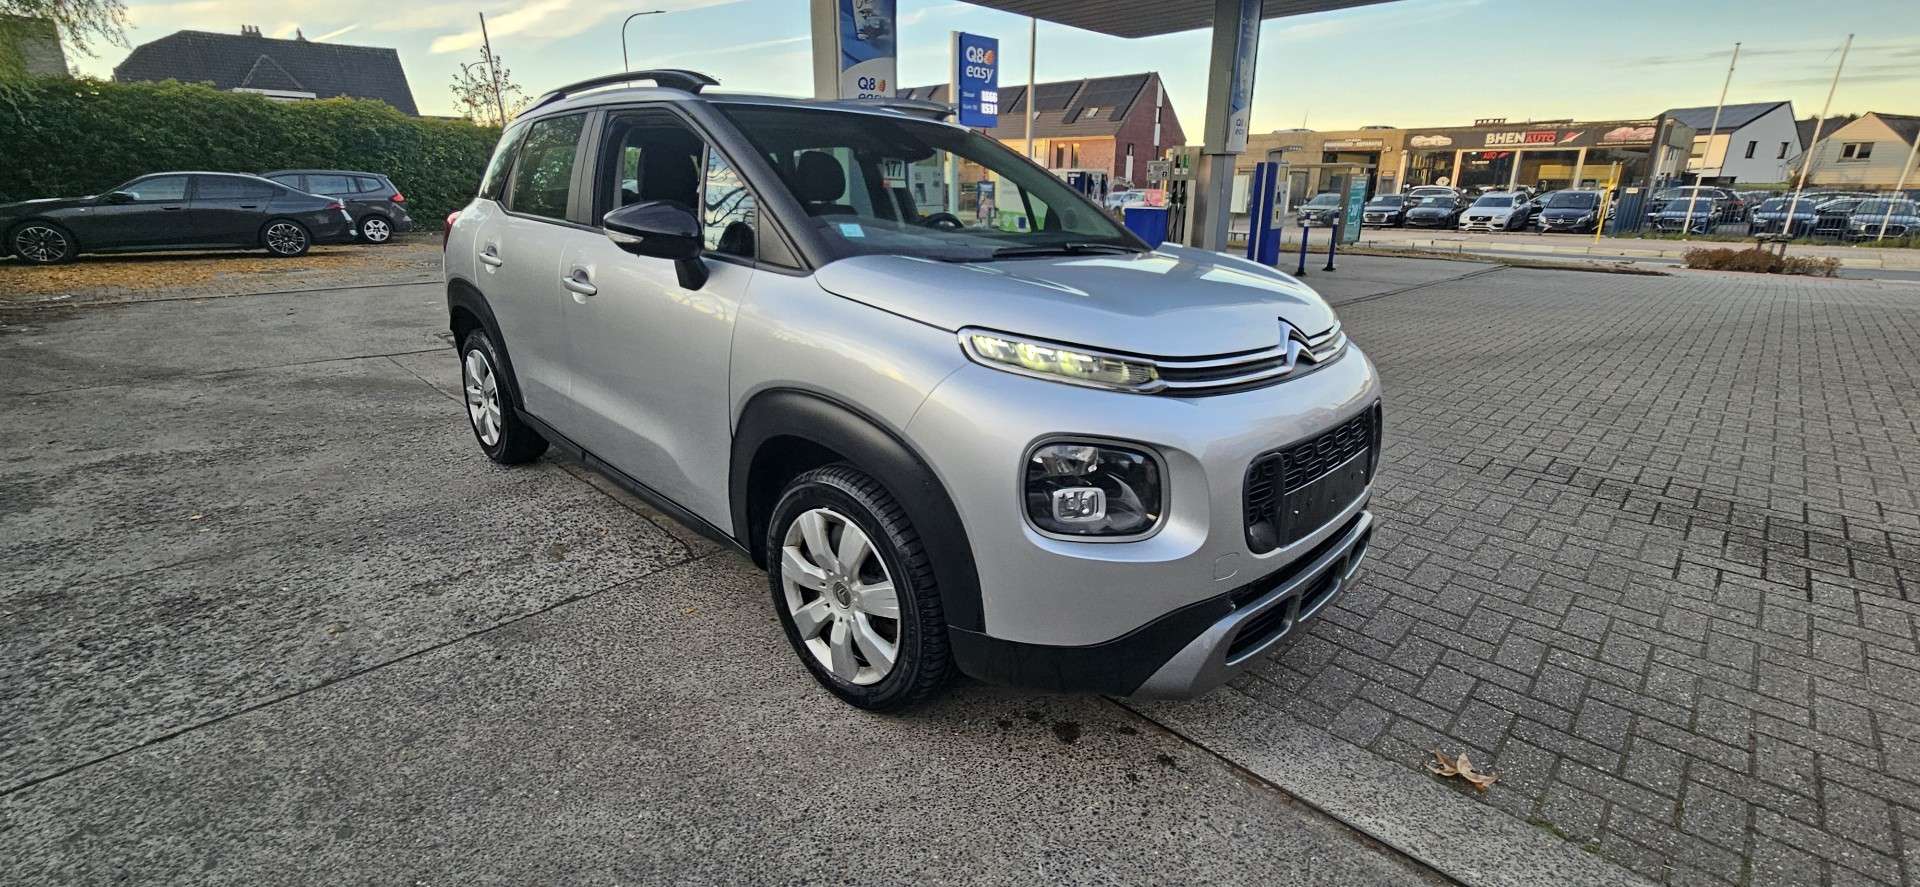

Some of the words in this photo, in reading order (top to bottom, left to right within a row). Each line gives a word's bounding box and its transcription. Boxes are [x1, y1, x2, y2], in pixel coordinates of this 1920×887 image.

[966, 46, 984, 63] Q8
[966, 65, 994, 83] easy
[858, 77, 876, 90] Q8
